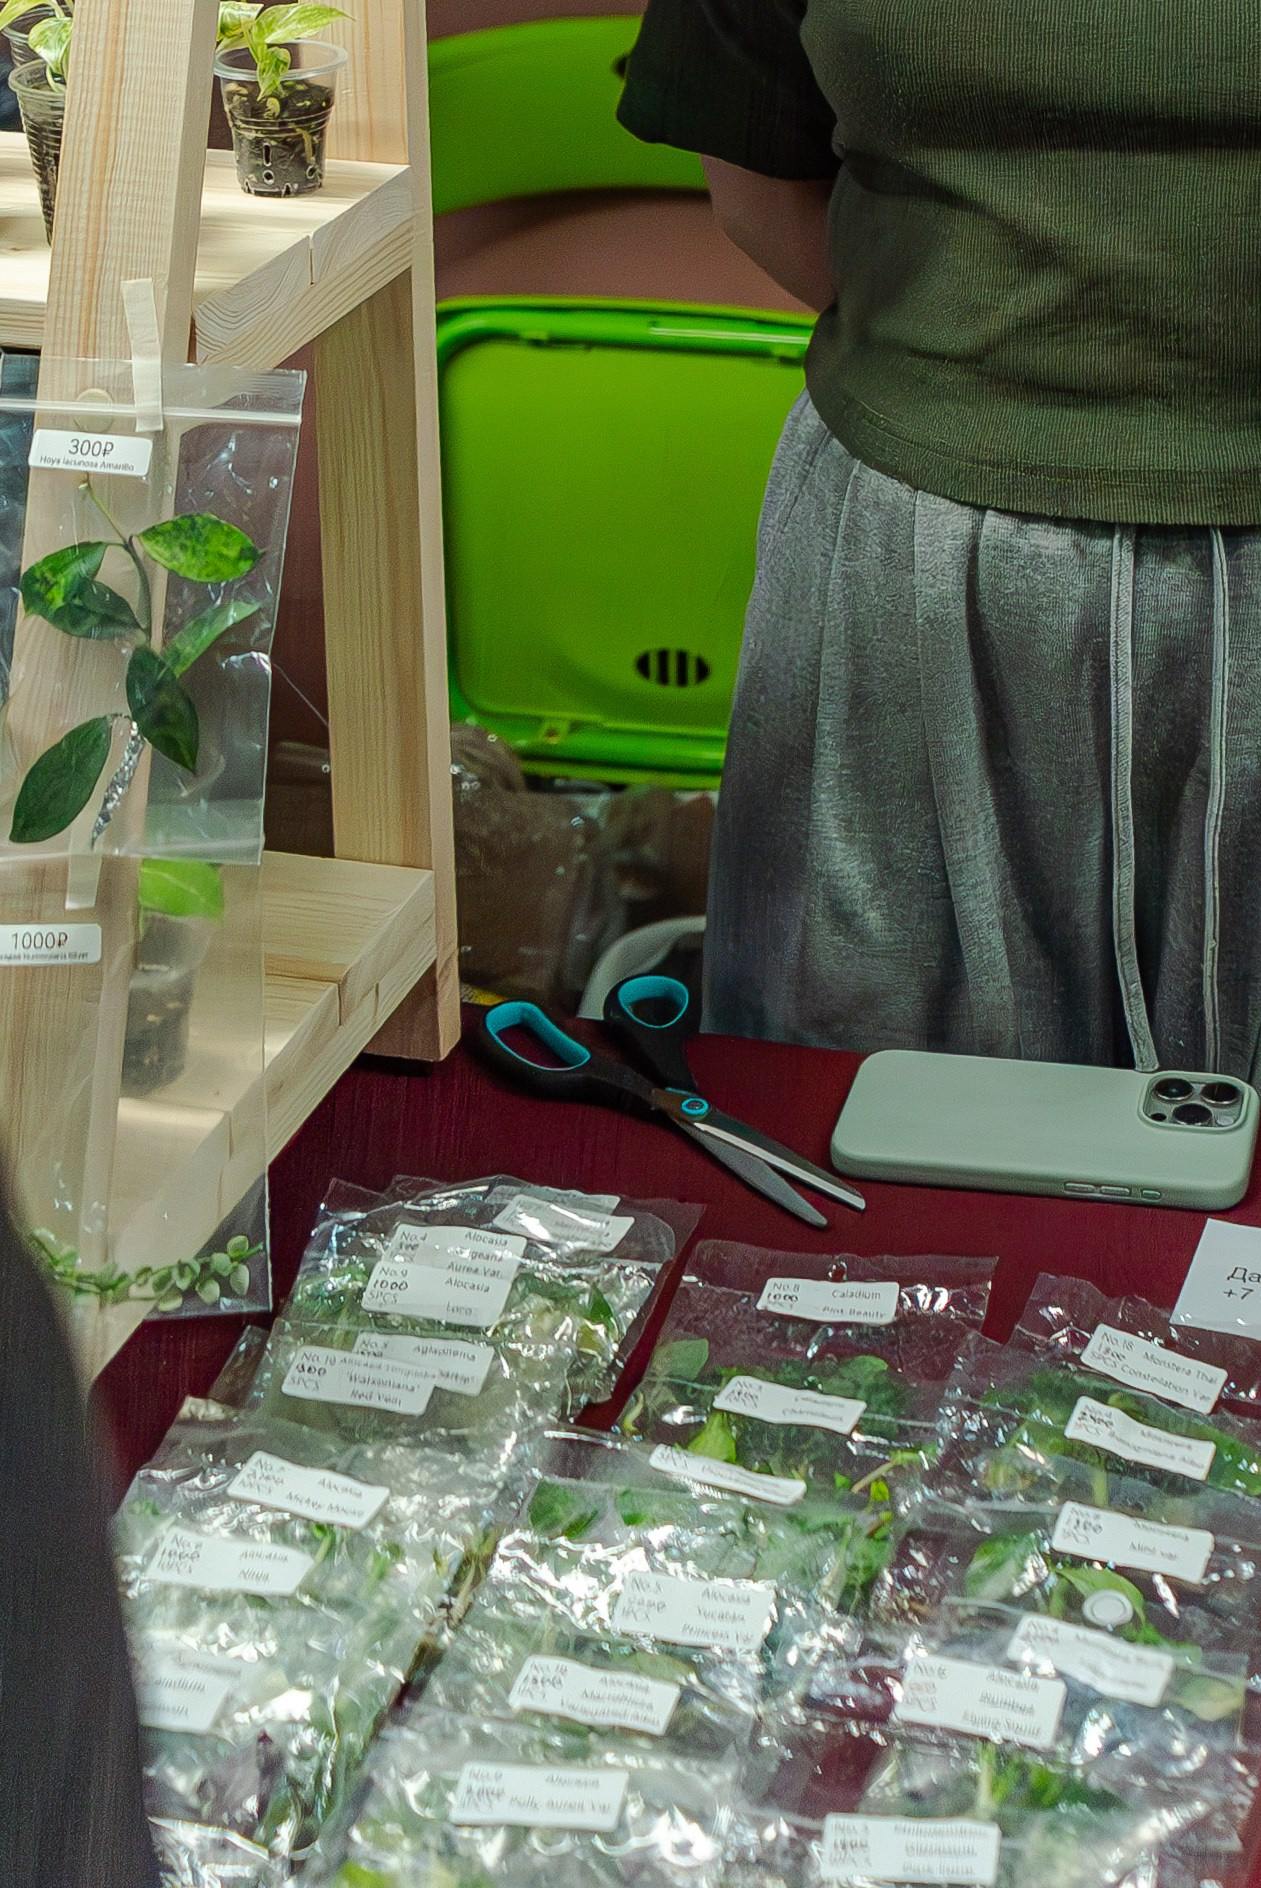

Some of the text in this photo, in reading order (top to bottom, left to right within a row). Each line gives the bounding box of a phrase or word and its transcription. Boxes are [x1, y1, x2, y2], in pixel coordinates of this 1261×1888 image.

[68, 437, 114, 458] 300₽
[12, 931, 68, 950] 1000₽
[1223, 1286, 1254, 1300] +7
